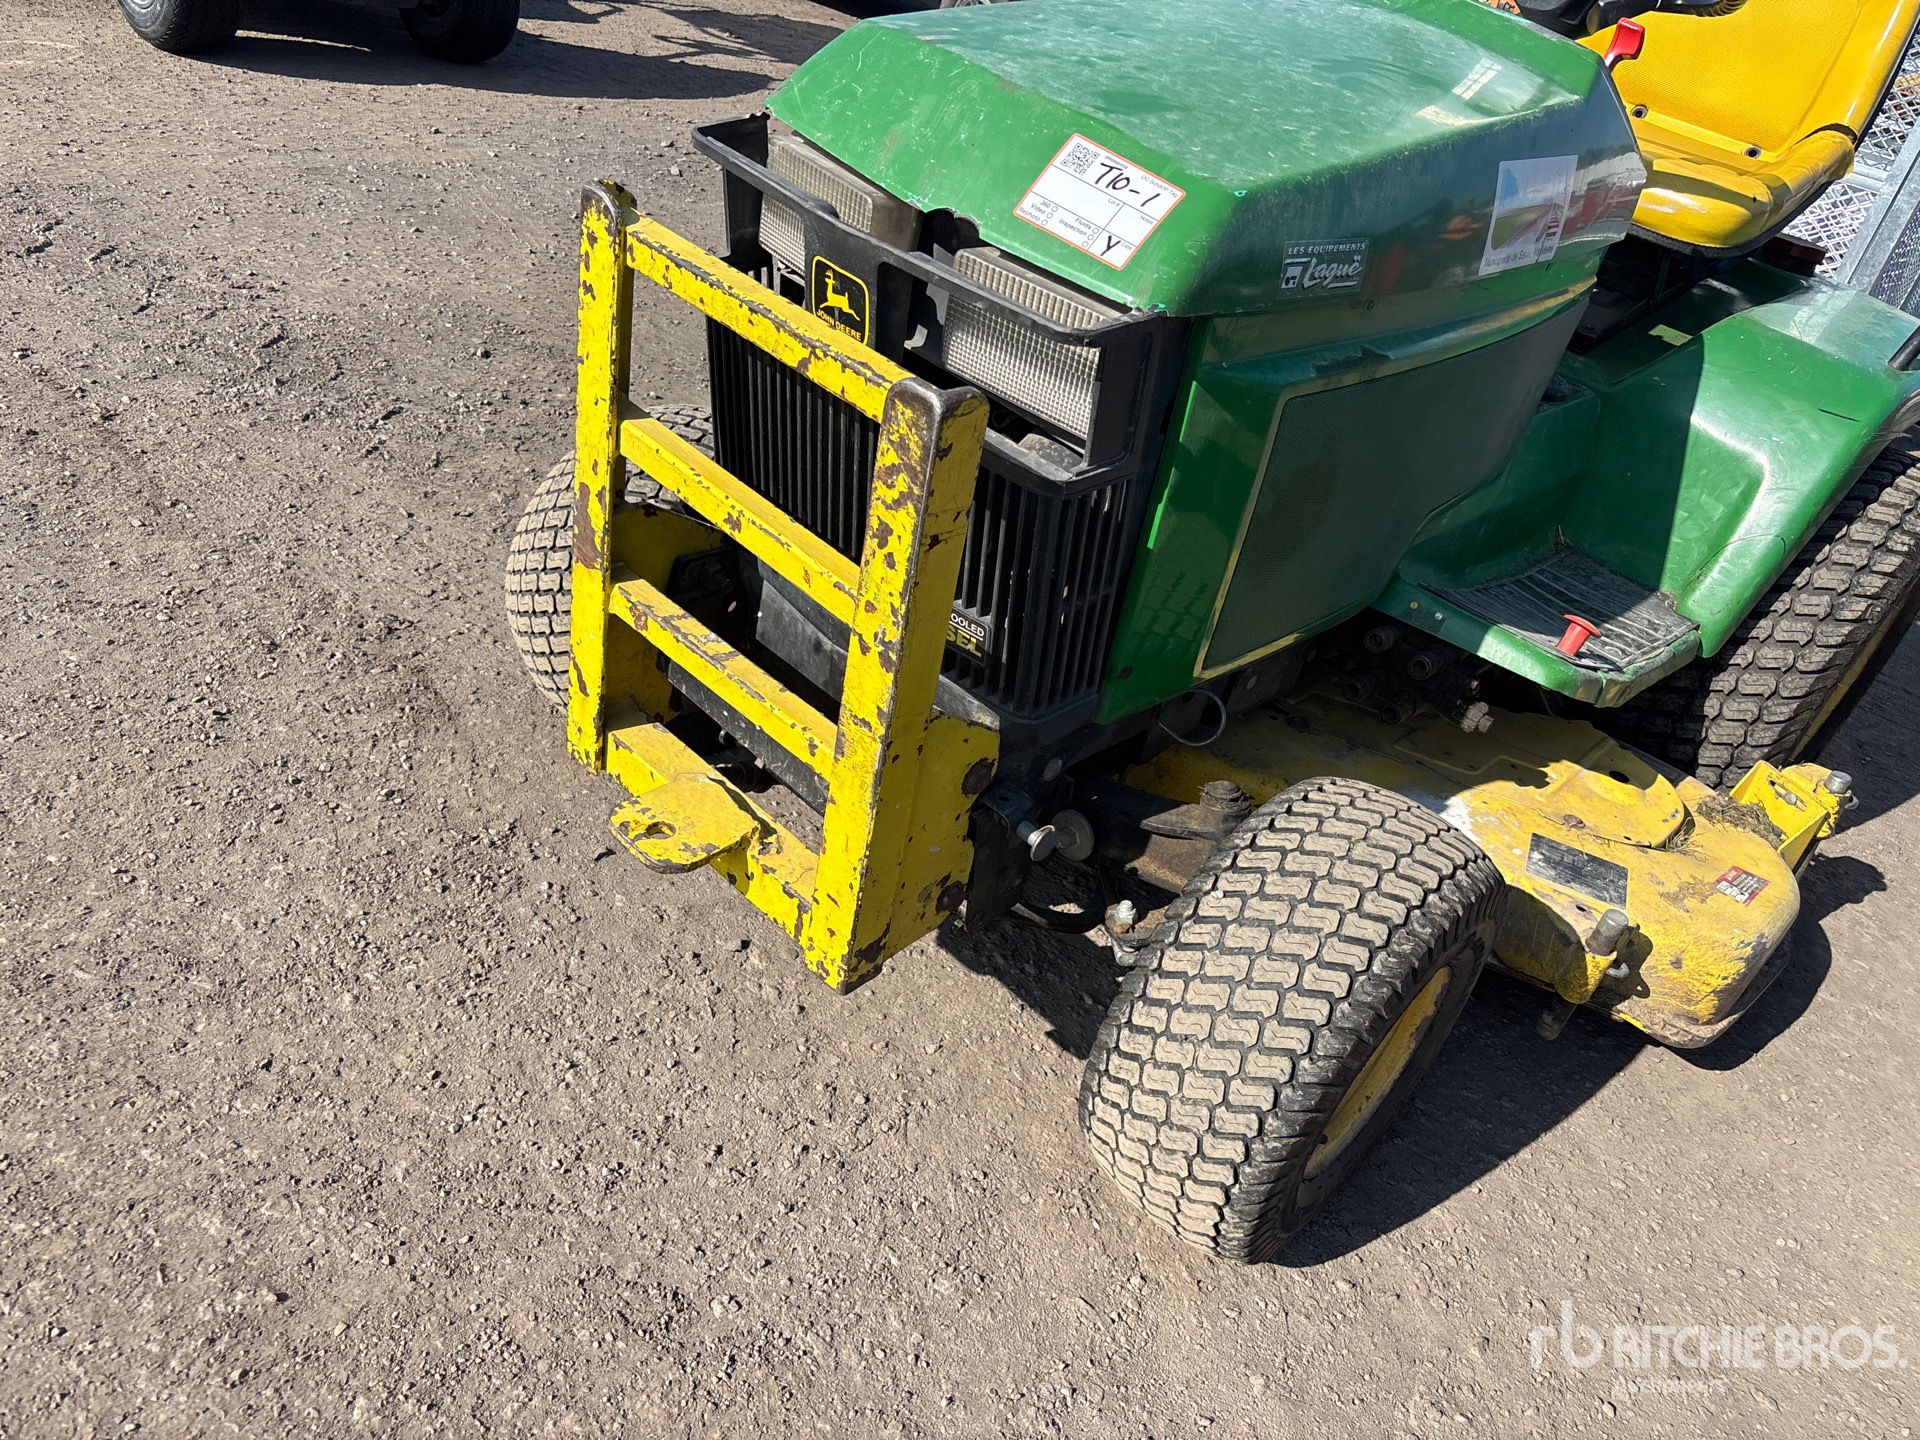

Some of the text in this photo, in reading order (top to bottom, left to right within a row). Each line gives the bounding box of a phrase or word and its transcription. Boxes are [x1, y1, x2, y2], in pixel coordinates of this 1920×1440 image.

[1031, 203, 1046, 215] Video
[1040, 200, 1051, 209] 360
[1018, 206, 1041, 222] Rephoto
[1058, 218, 1088, 237] Inspection
[1074, 217, 1092, 230] Fluids
[1288, 246, 1305, 255] LES
[816, 308, 862, 341] JOHN DEERE
[950, 613, 985, 637] OOLED
[946, 624, 982, 658] SEL
